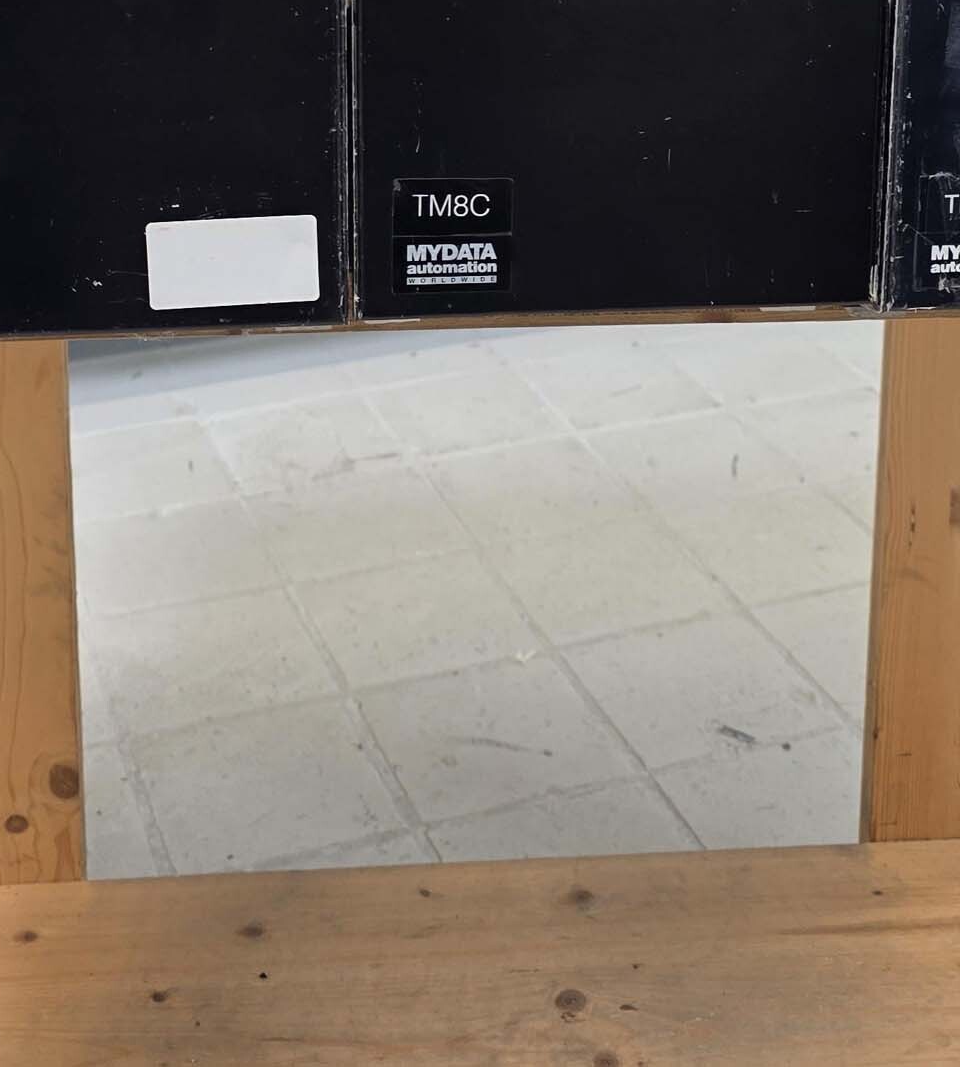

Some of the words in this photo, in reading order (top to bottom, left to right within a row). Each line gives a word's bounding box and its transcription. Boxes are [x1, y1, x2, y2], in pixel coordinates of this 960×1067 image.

[411, 193, 490, 217] TM8C
[406, 242, 497, 262] MYDATA
[930, 244, 960, 261] MY
[406, 261, 497, 275] automation
[407, 275, 497, 285] WORLDWIDE
